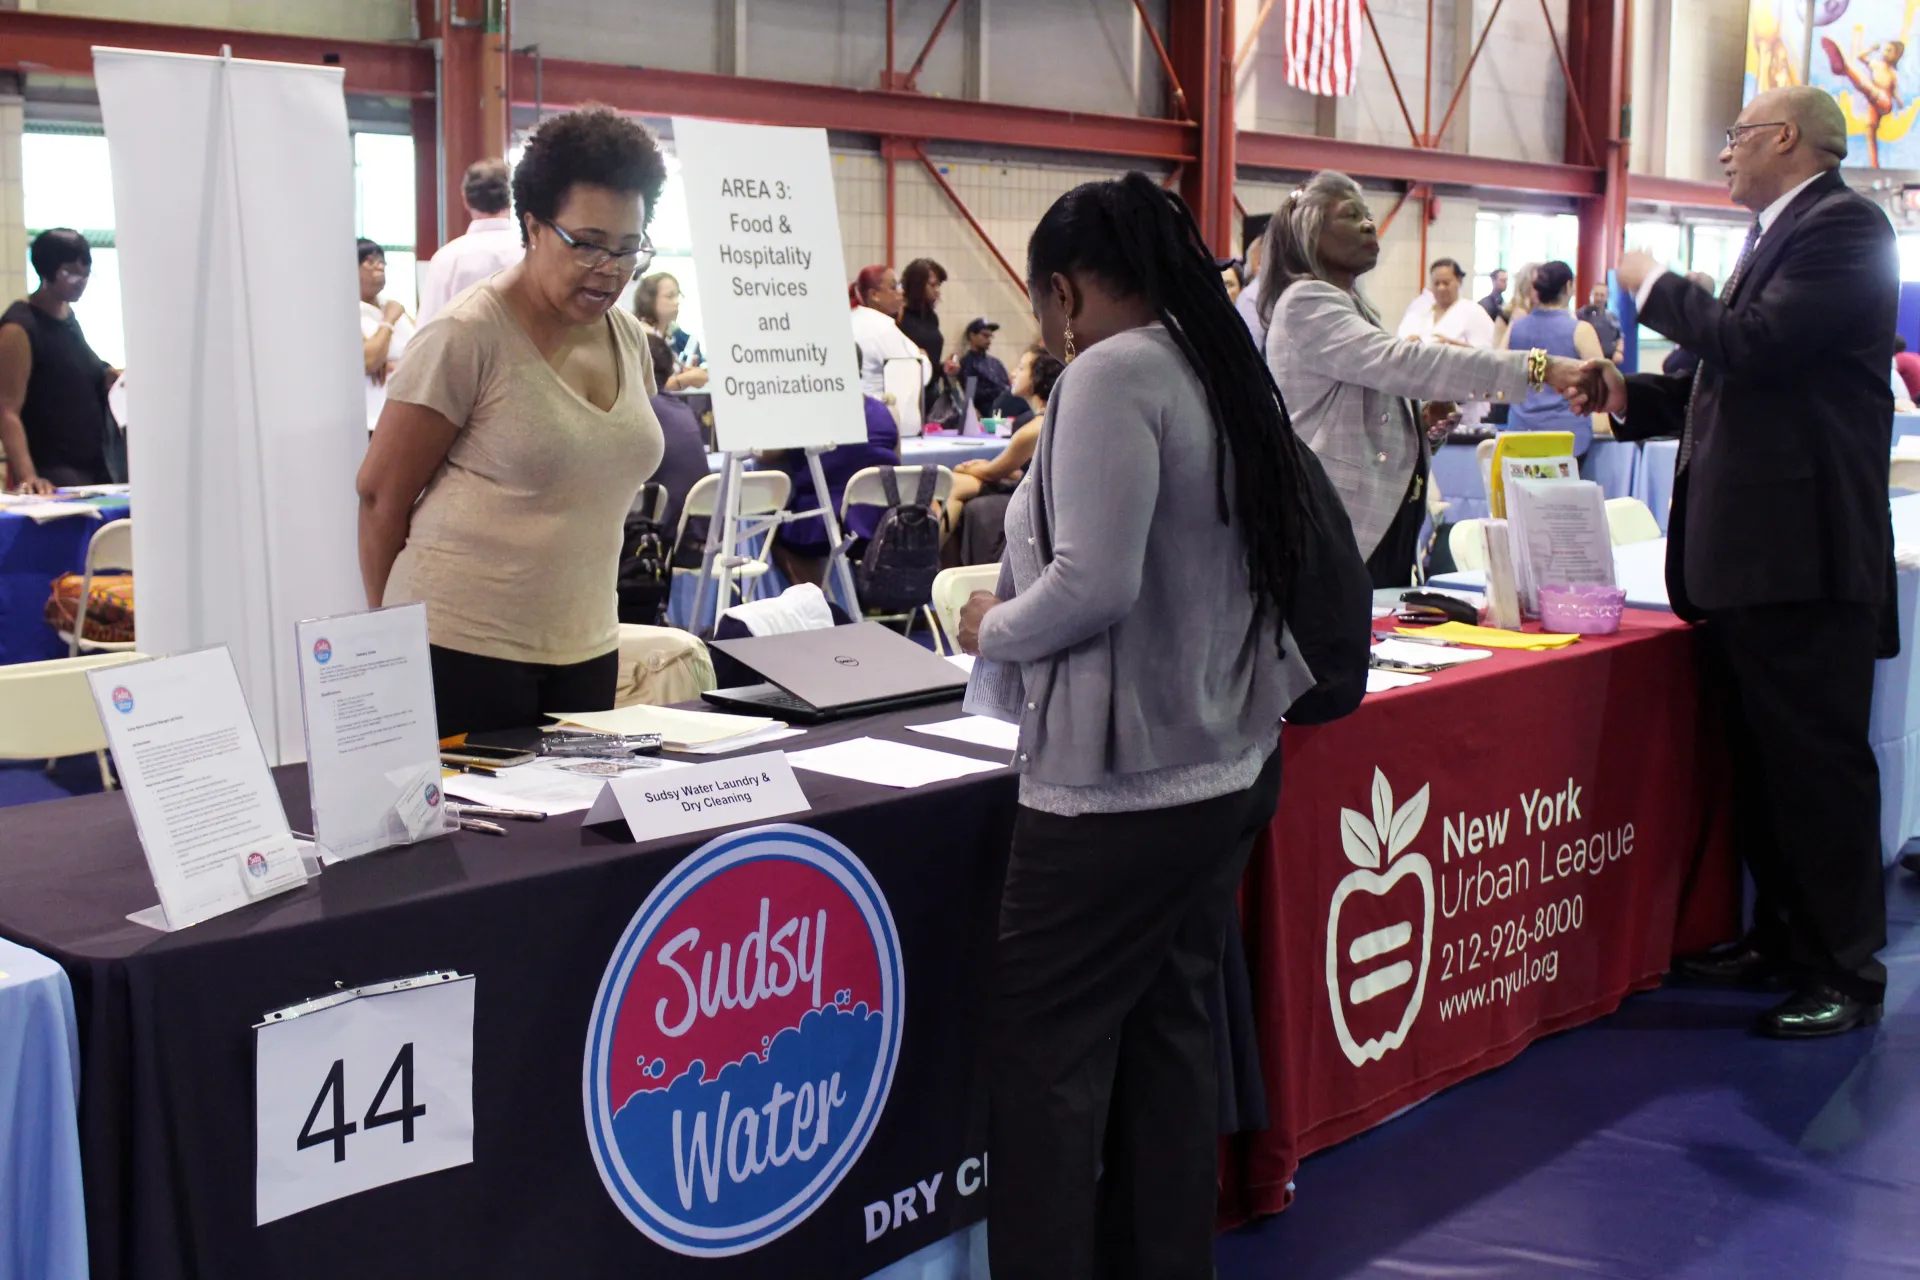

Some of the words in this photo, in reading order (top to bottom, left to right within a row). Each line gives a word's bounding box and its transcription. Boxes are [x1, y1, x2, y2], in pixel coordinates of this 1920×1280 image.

[721, 178, 770, 200] AREA
[775, 181, 792, 201] 3:
[729, 213, 773, 233] Food
[779, 215, 792, 234] &
[719, 244, 812, 270] Hospitality
[732, 277, 808, 297] Services
[758, 313, 790, 331] and
[731, 344, 828, 366] Community
[725, 375, 845, 400] Organizations
[644, 790, 679, 803] Sudsy
[681, 783, 713, 796] Water
[715, 775, 759, 791] Laundry
[761, 772, 771, 782] &
[681, 801, 702, 812] Dry
[703, 791, 752, 808] Cleaning
[1443, 808, 1510, 863] New
[1520, 777, 1582, 836] York
[1442, 858, 1529, 918] Urban
[1540, 823, 1634, 884] League
[1440, 894, 1583, 981] 212-926-8000
[655, 898, 826, 1037] Sudsy
[1440, 950, 1558, 1022] www.nyul.org
[297, 1042, 426, 1163] 44
[672, 1072, 846, 1211] Water
[864, 1172, 943, 1244] DRY
